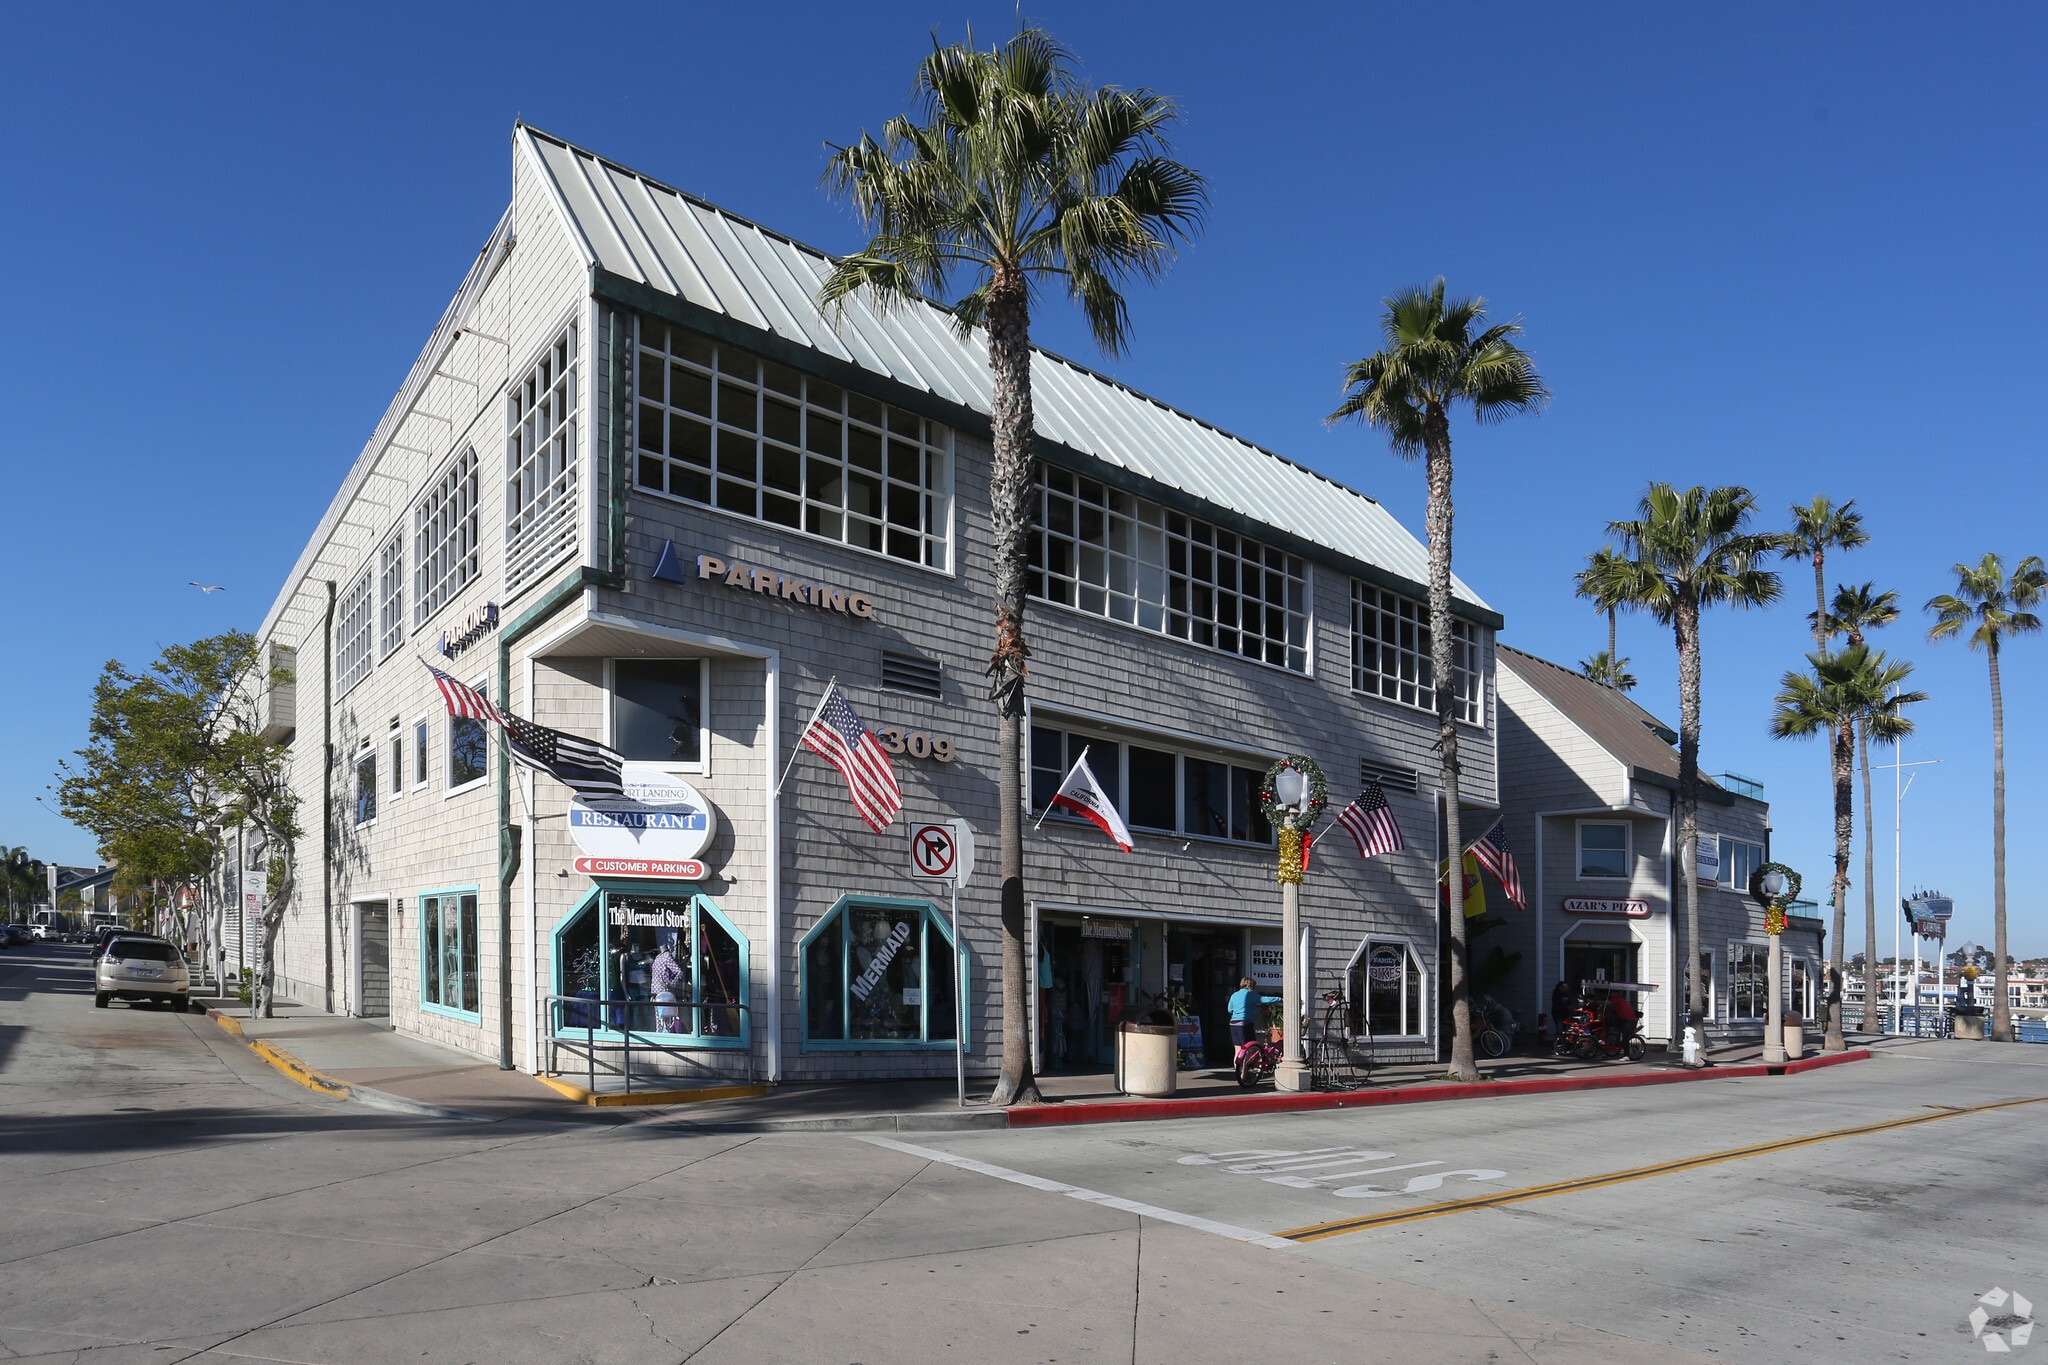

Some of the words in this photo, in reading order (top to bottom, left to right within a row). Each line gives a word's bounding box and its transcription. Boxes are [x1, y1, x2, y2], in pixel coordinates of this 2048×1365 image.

[697, 554, 873, 618] PARKING
[444, 601, 490, 651] PARKING
[882, 727, 955, 763] 309
[643, 788, 685, 799] LANDING
[1070, 790, 1100, 810] CALIFORNIA
[581, 811, 697, 829] RESTAURANT
[595, 860, 648, 873] CUSTOMER
[651, 863, 697, 874] PARKING
[1568, 901, 1608, 911] AZAR'S
[1612, 903, 1645, 913] PIZZA
[609, 907, 626, 926] The
[626, 908, 665, 928] Mermaid
[665, 909, 690, 928] Store
[1082, 920, 1093, 936] The
[1093, 921, 1118, 938] Mermaid
[1117, 923, 1133, 940] Store
[850, 921, 910, 1002] MERMAID
[1253, 957, 1283, 965] RENT
[1371, 966, 1402, 980] BIKES
